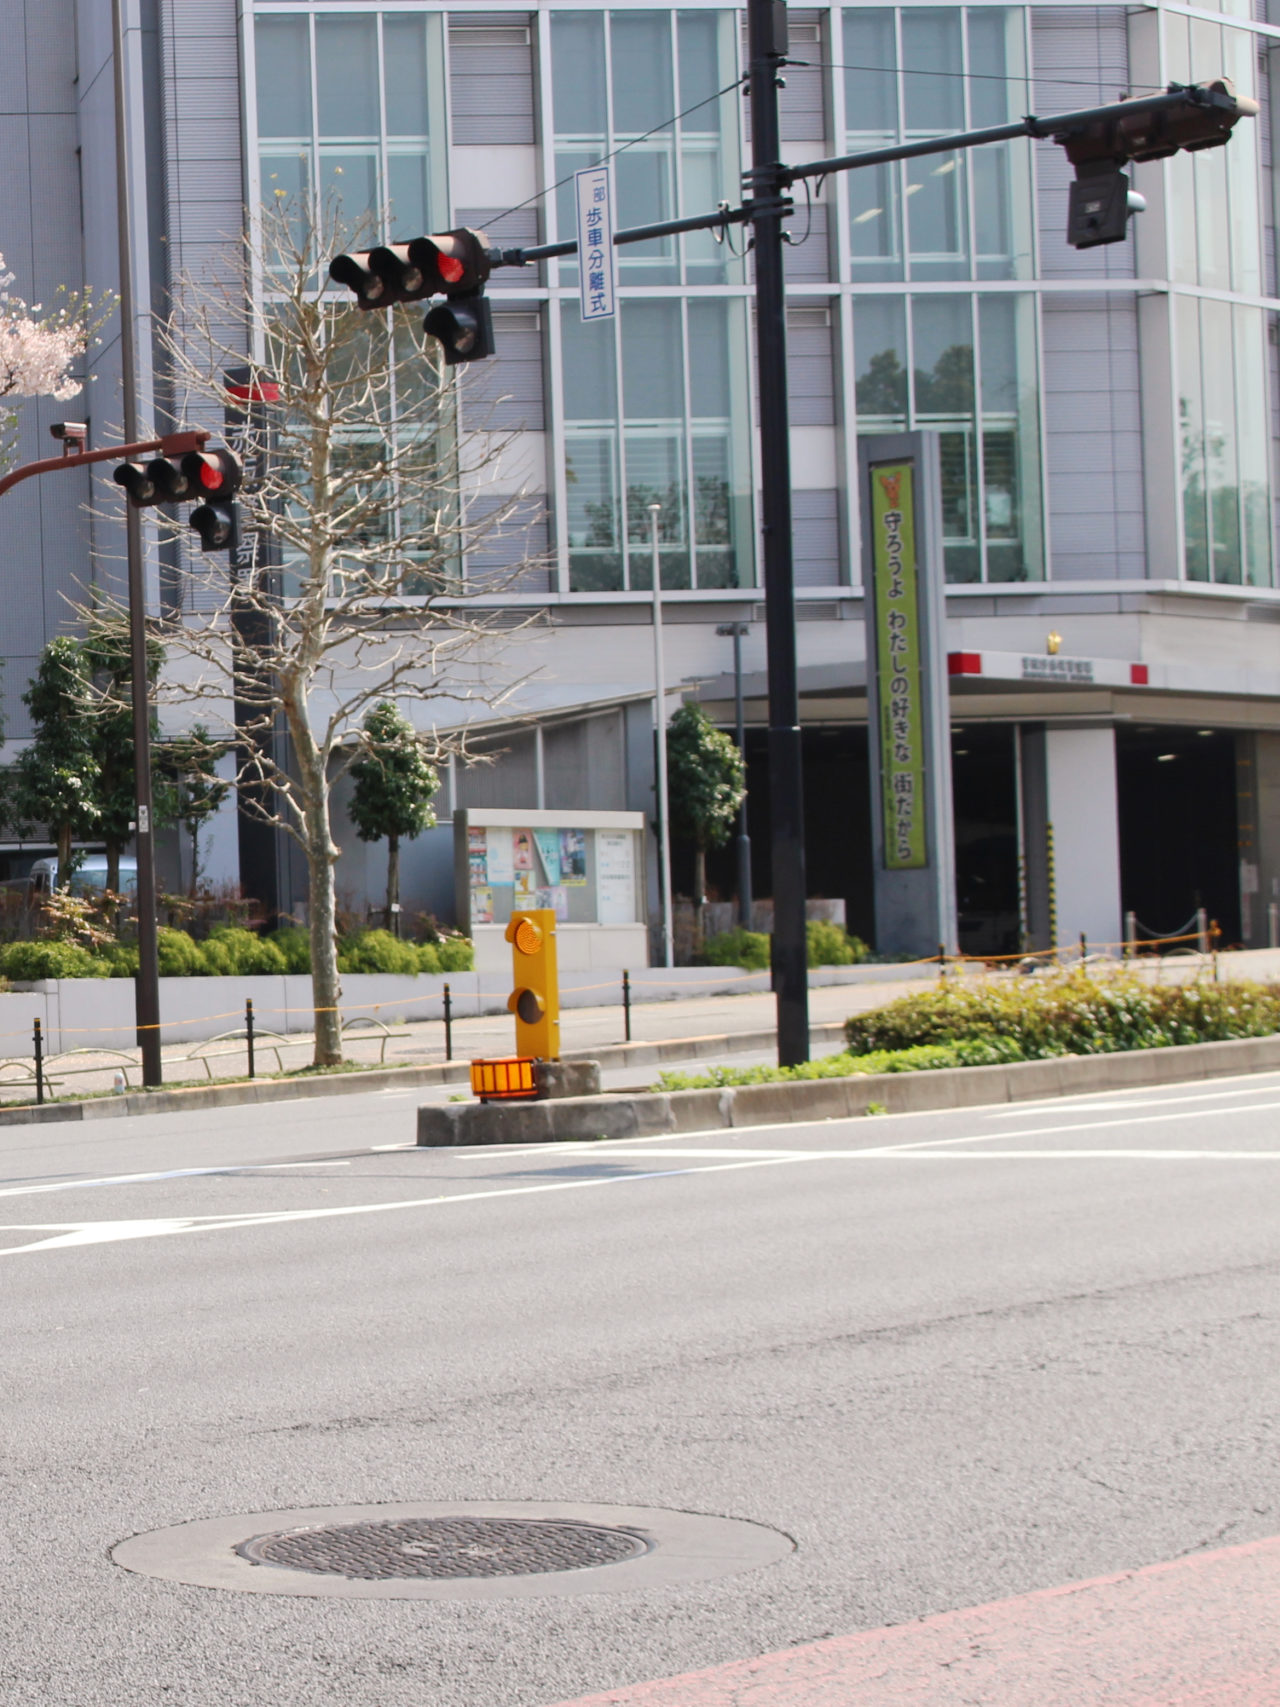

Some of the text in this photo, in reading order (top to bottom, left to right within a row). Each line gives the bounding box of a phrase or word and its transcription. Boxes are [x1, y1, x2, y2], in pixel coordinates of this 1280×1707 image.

[883, 511, 904, 599] 守ろうよ
[887, 609, 911, 763] わたしの好きな
